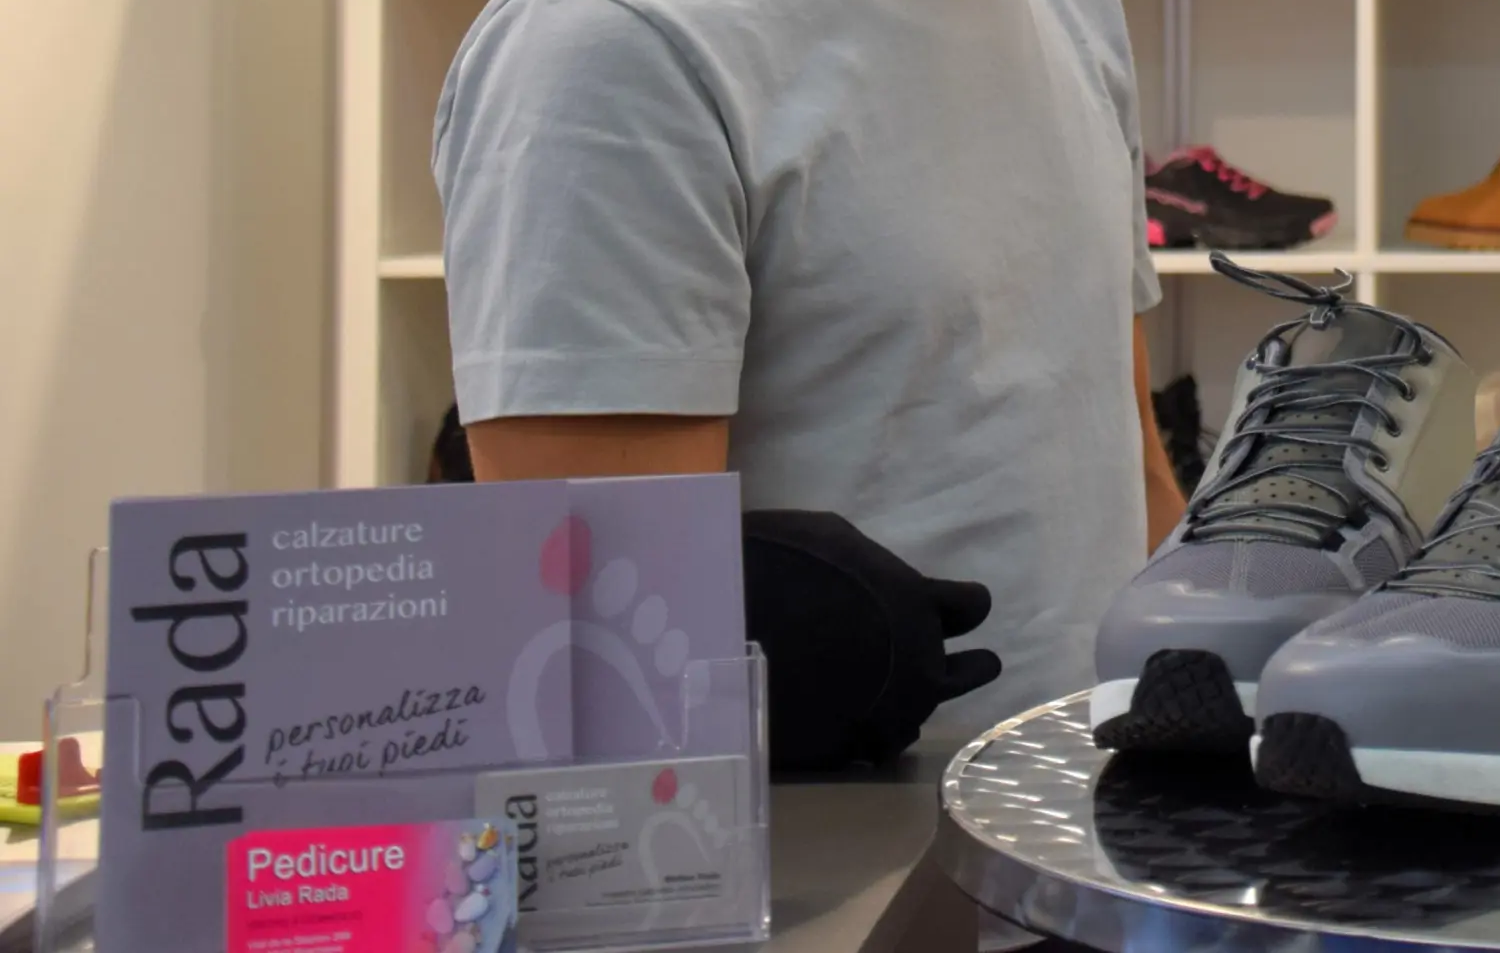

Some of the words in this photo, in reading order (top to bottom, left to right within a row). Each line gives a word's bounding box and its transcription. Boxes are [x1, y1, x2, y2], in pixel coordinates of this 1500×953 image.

[272, 521, 423, 550] calzature
[272, 554, 434, 591] ortopedia
[272, 589, 448, 633] riparazioni
[130, 532, 249, 831] Rada
[265, 685, 486, 765] personalizza
[301, 740, 370, 781] tuoi
[376, 717, 469, 777] piedi
[247, 844, 405, 881] Pedicure
[246, 891, 292, 909] Livia
[298, 884, 349, 904] Rada
